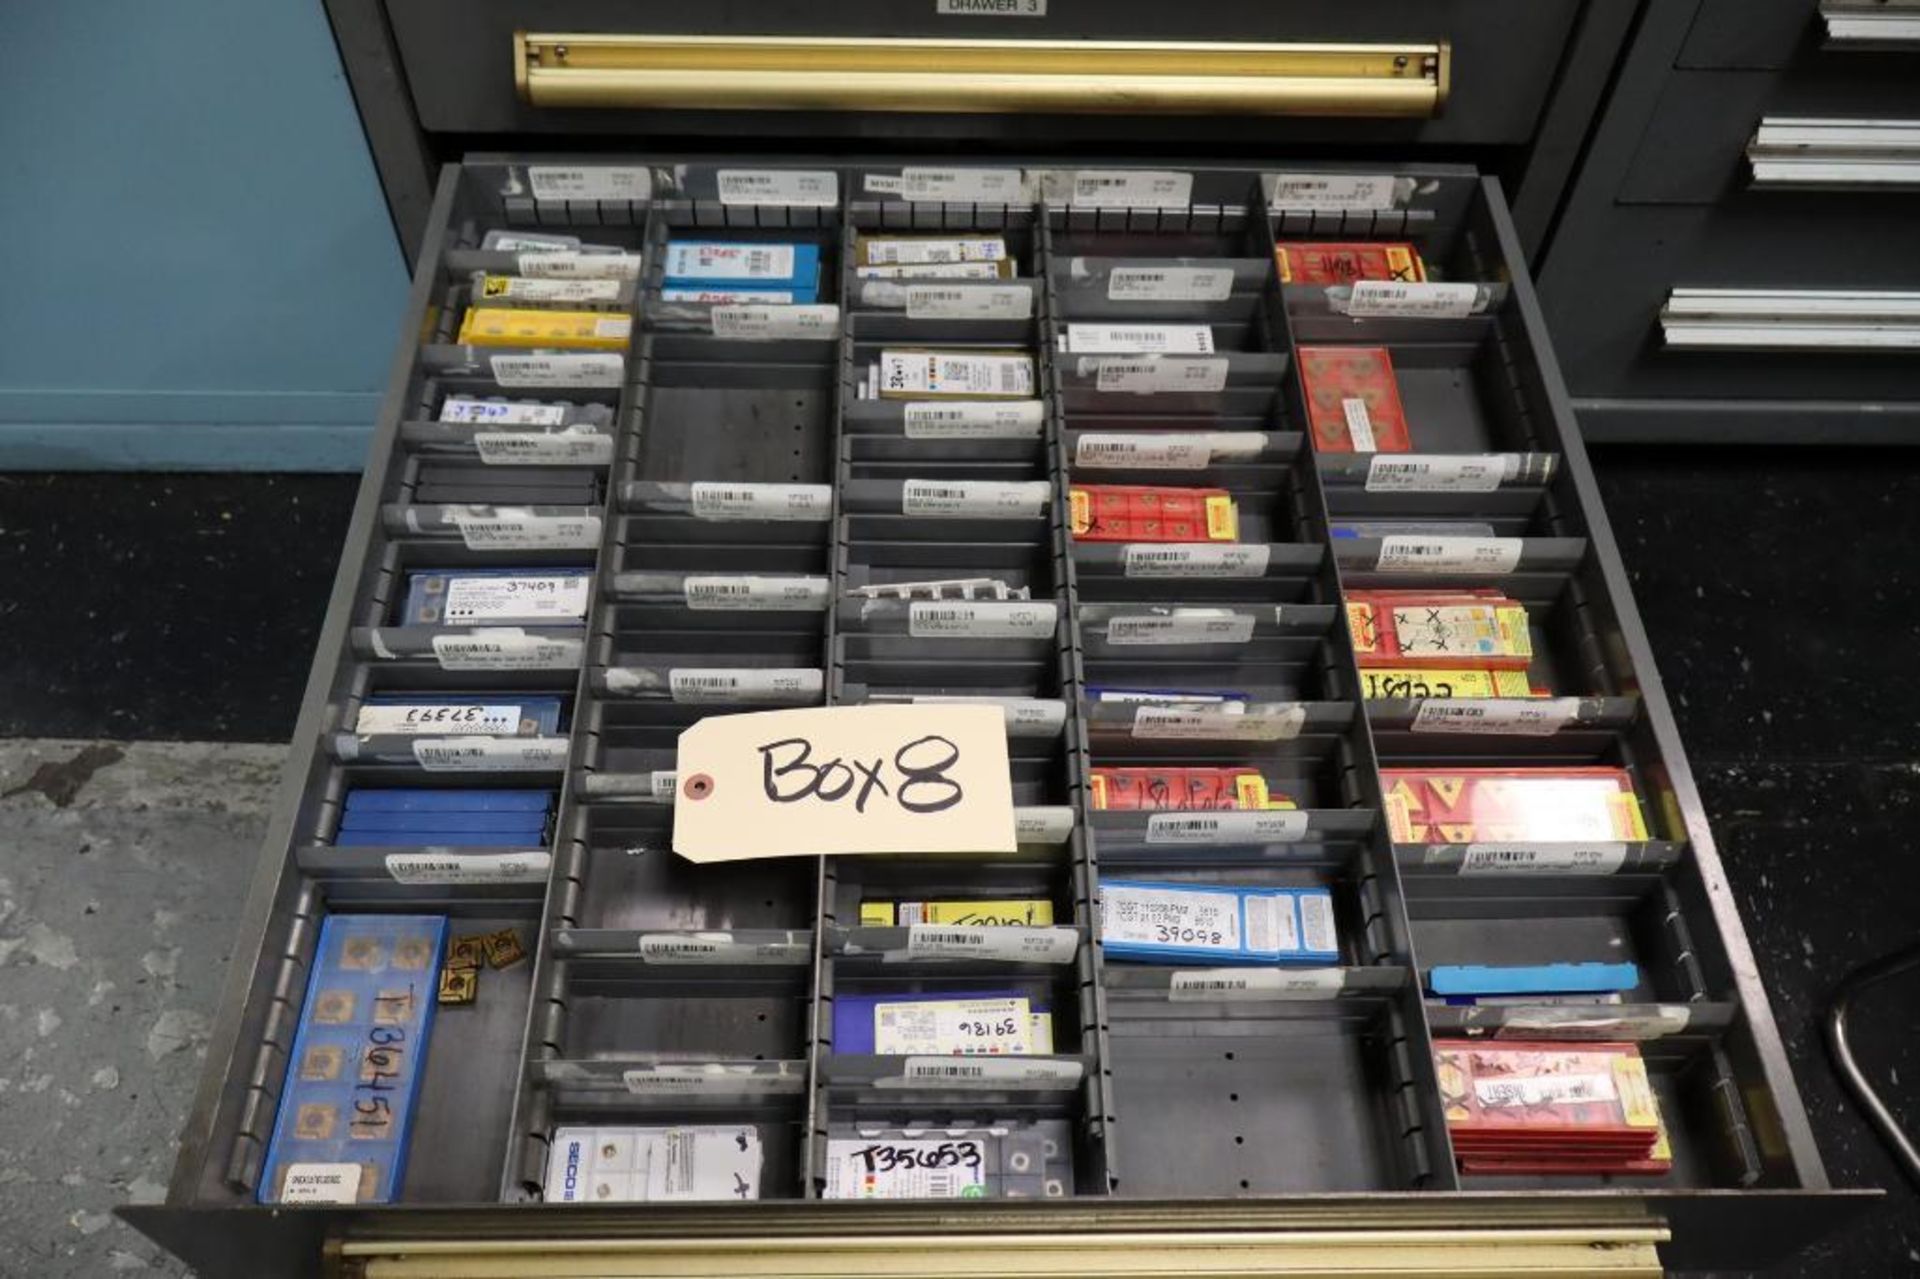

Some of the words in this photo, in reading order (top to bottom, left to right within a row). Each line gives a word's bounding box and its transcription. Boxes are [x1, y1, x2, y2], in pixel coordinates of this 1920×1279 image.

[949, 0, 1018, 11] DRAWER
[1027, 0, 1038, 12] 3
[757, 738, 889, 813] Box
[894, 735, 964, 813] 8
[1155, 924, 1223, 945] 39098
[565, 1141, 581, 1190] SECO
[850, 1141, 982, 1172] T35653
